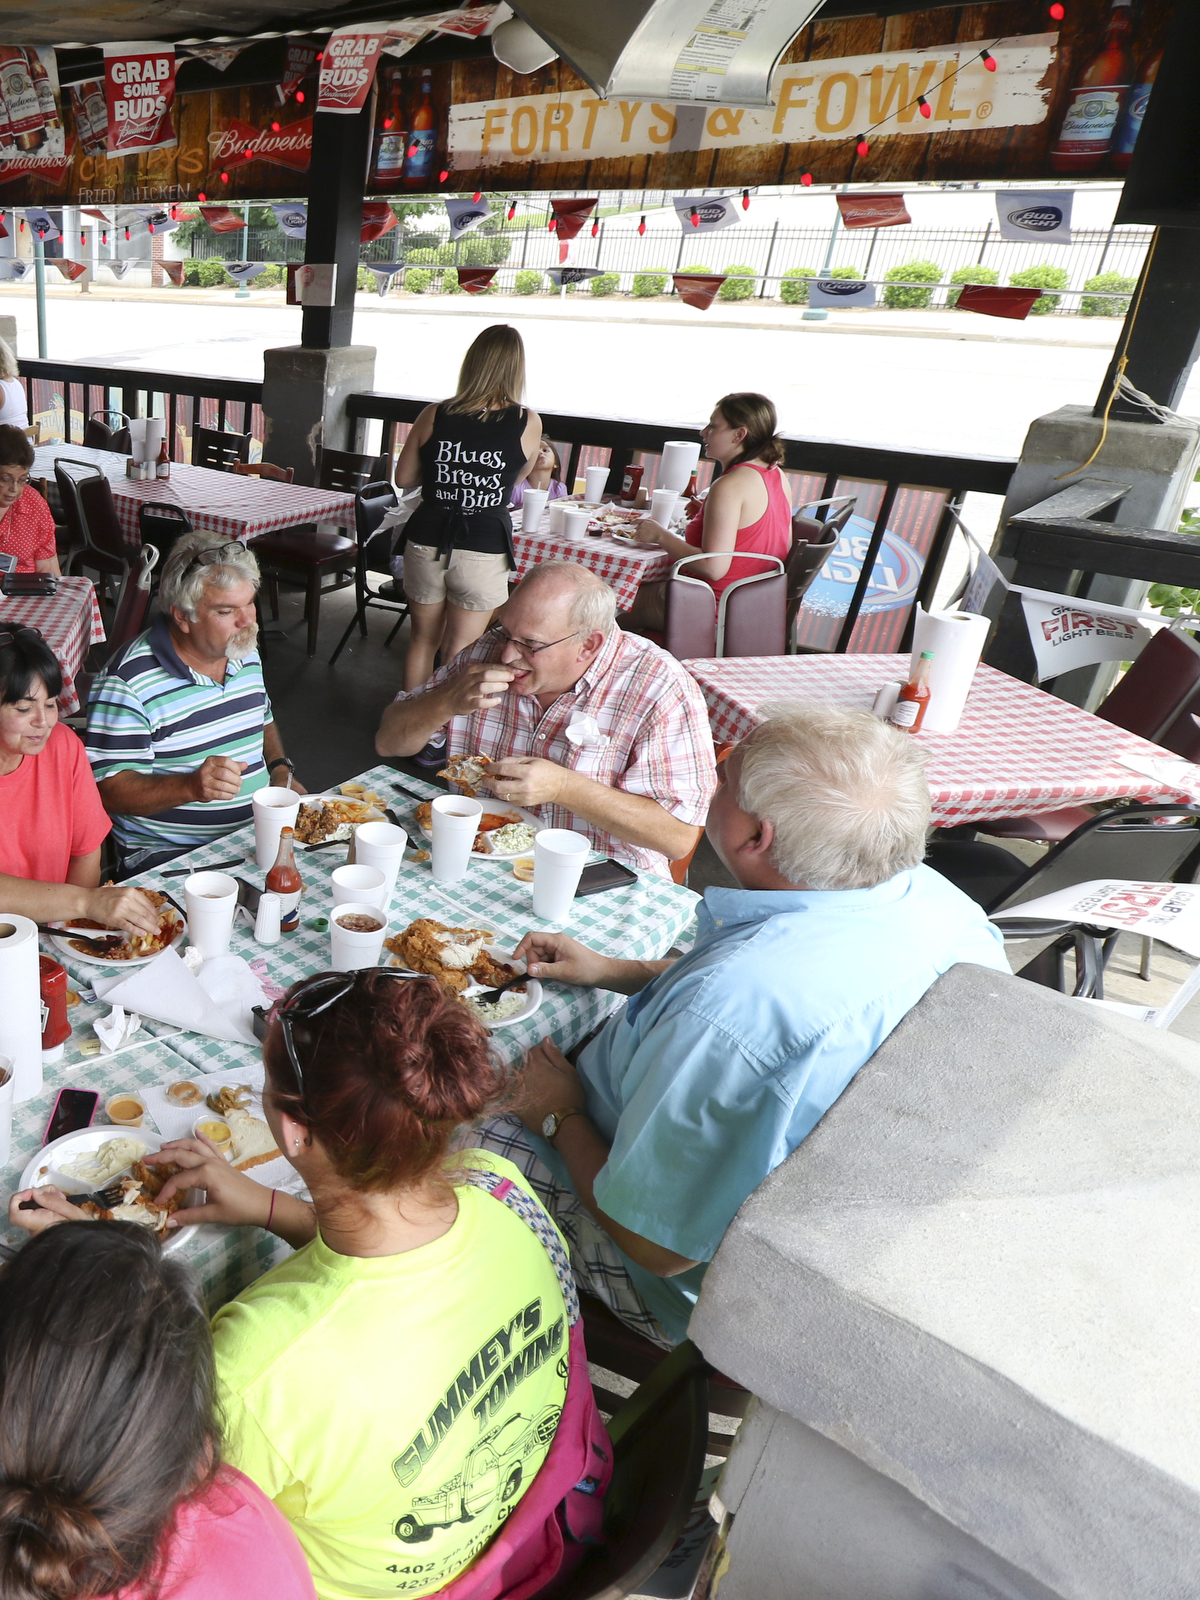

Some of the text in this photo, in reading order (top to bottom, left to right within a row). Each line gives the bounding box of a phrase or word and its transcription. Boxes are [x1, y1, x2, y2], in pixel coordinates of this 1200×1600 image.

[328, 38, 380, 57] GRAB
[111, 59, 170, 84] GRAB
[332, 56, 366, 68] SOME
[320, 68, 370, 86] BUDS
[123, 82, 161, 98] SOME
[6, 94, 37, 110] Budweise
[114, 96, 167, 122] BUDS
[481, 60, 972, 156] FORTYS & FOWL
[1062, 120, 1117, 131] Budweiser
[207, 128, 313, 158] Budweise
[79, 146, 204, 182] CHAPYS
[77, 183, 191, 204] FRIED CHICKEN
[1017, 218, 1060, 227] LIGHT
[1022, 211, 1057, 220] BUD
[434, 440, 507, 470] Blues,
[435, 463, 502, 490] Brews
[435, 486, 506, 508] and Bird
[1040, 611, 1139, 641] FIRST
[1052, 628, 1134, 647] LIGHT BEER
[1091, 883, 1177, 926] FIRST
[471, 1314, 565, 1434] TOWING
[392, 1296, 542, 1487] SUMMEY'S
[385, 1562, 436, 1574] 4402
